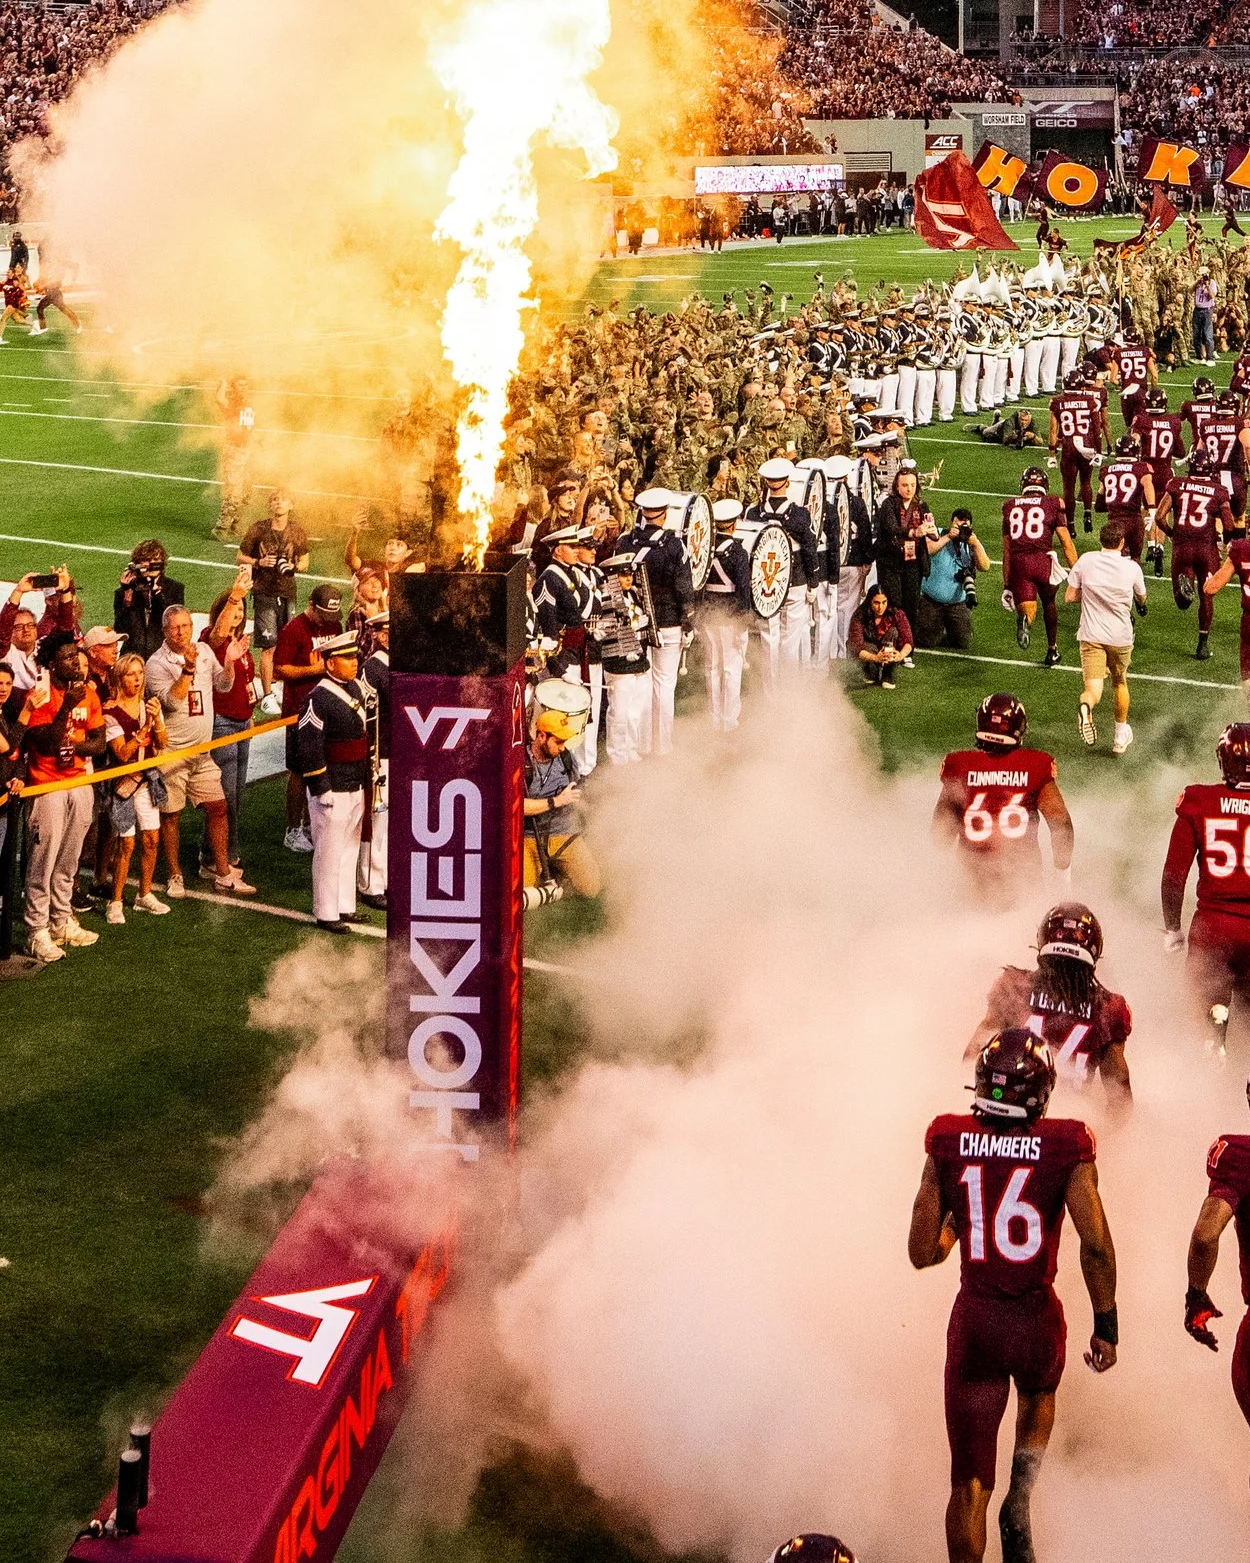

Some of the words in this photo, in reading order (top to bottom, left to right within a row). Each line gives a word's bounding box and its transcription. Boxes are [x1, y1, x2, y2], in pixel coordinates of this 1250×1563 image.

[983, 115, 1009, 125] WORSHAM
[1010, 115, 1025, 125] FIELD
[1035, 118, 1078, 128] GEICO
[932, 135, 959, 146] ACC
[1120, 357, 1147, 379] 95
[1060, 409, 1091, 437] 85
[1149, 429, 1174, 459] 19
[1206, 434, 1237, 464] 87
[1104, 472, 1138, 504] 89
[1008, 505, 1046, 540] 88
[1178, 491, 1212, 528] 13
[404, 705, 493, 751] VT
[966, 770, 1029, 787] CUNNINGHAM
[963, 792, 1030, 842] 66
[1052, 945, 1081, 957] HOKIES
[407, 777, 483, 1162] HOKIES
[959, 1131, 1042, 1161] CHAMBERS
[959, 1165, 1043, 1262] 16
[274, 1326, 394, 1563] IRGINIA
